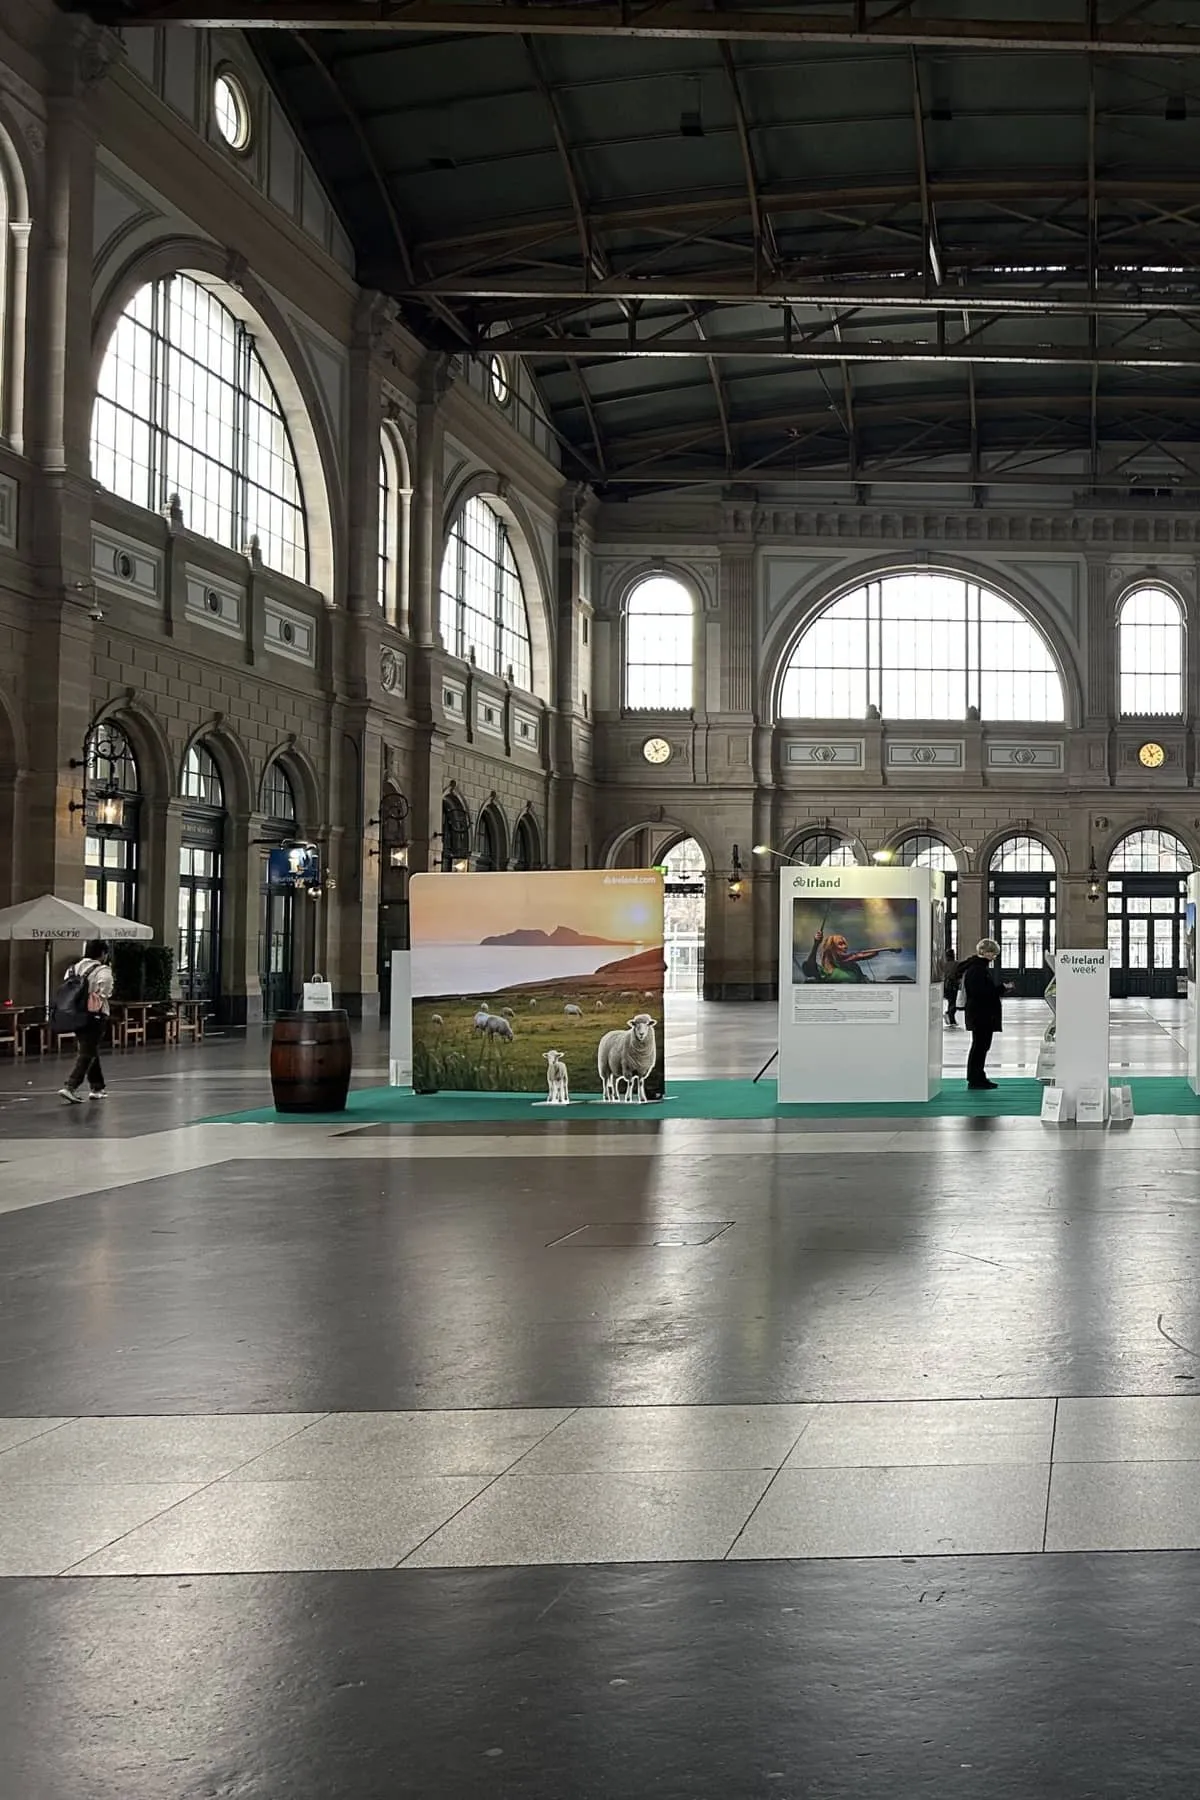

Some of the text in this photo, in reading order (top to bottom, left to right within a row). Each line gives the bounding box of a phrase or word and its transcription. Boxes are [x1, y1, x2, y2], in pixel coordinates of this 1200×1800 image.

[807, 877, 841, 888] Irland
[31, 928, 80, 938] Brasserie
[1071, 955, 1105, 965] Ireland
[1071, 965, 1097, 974] week
